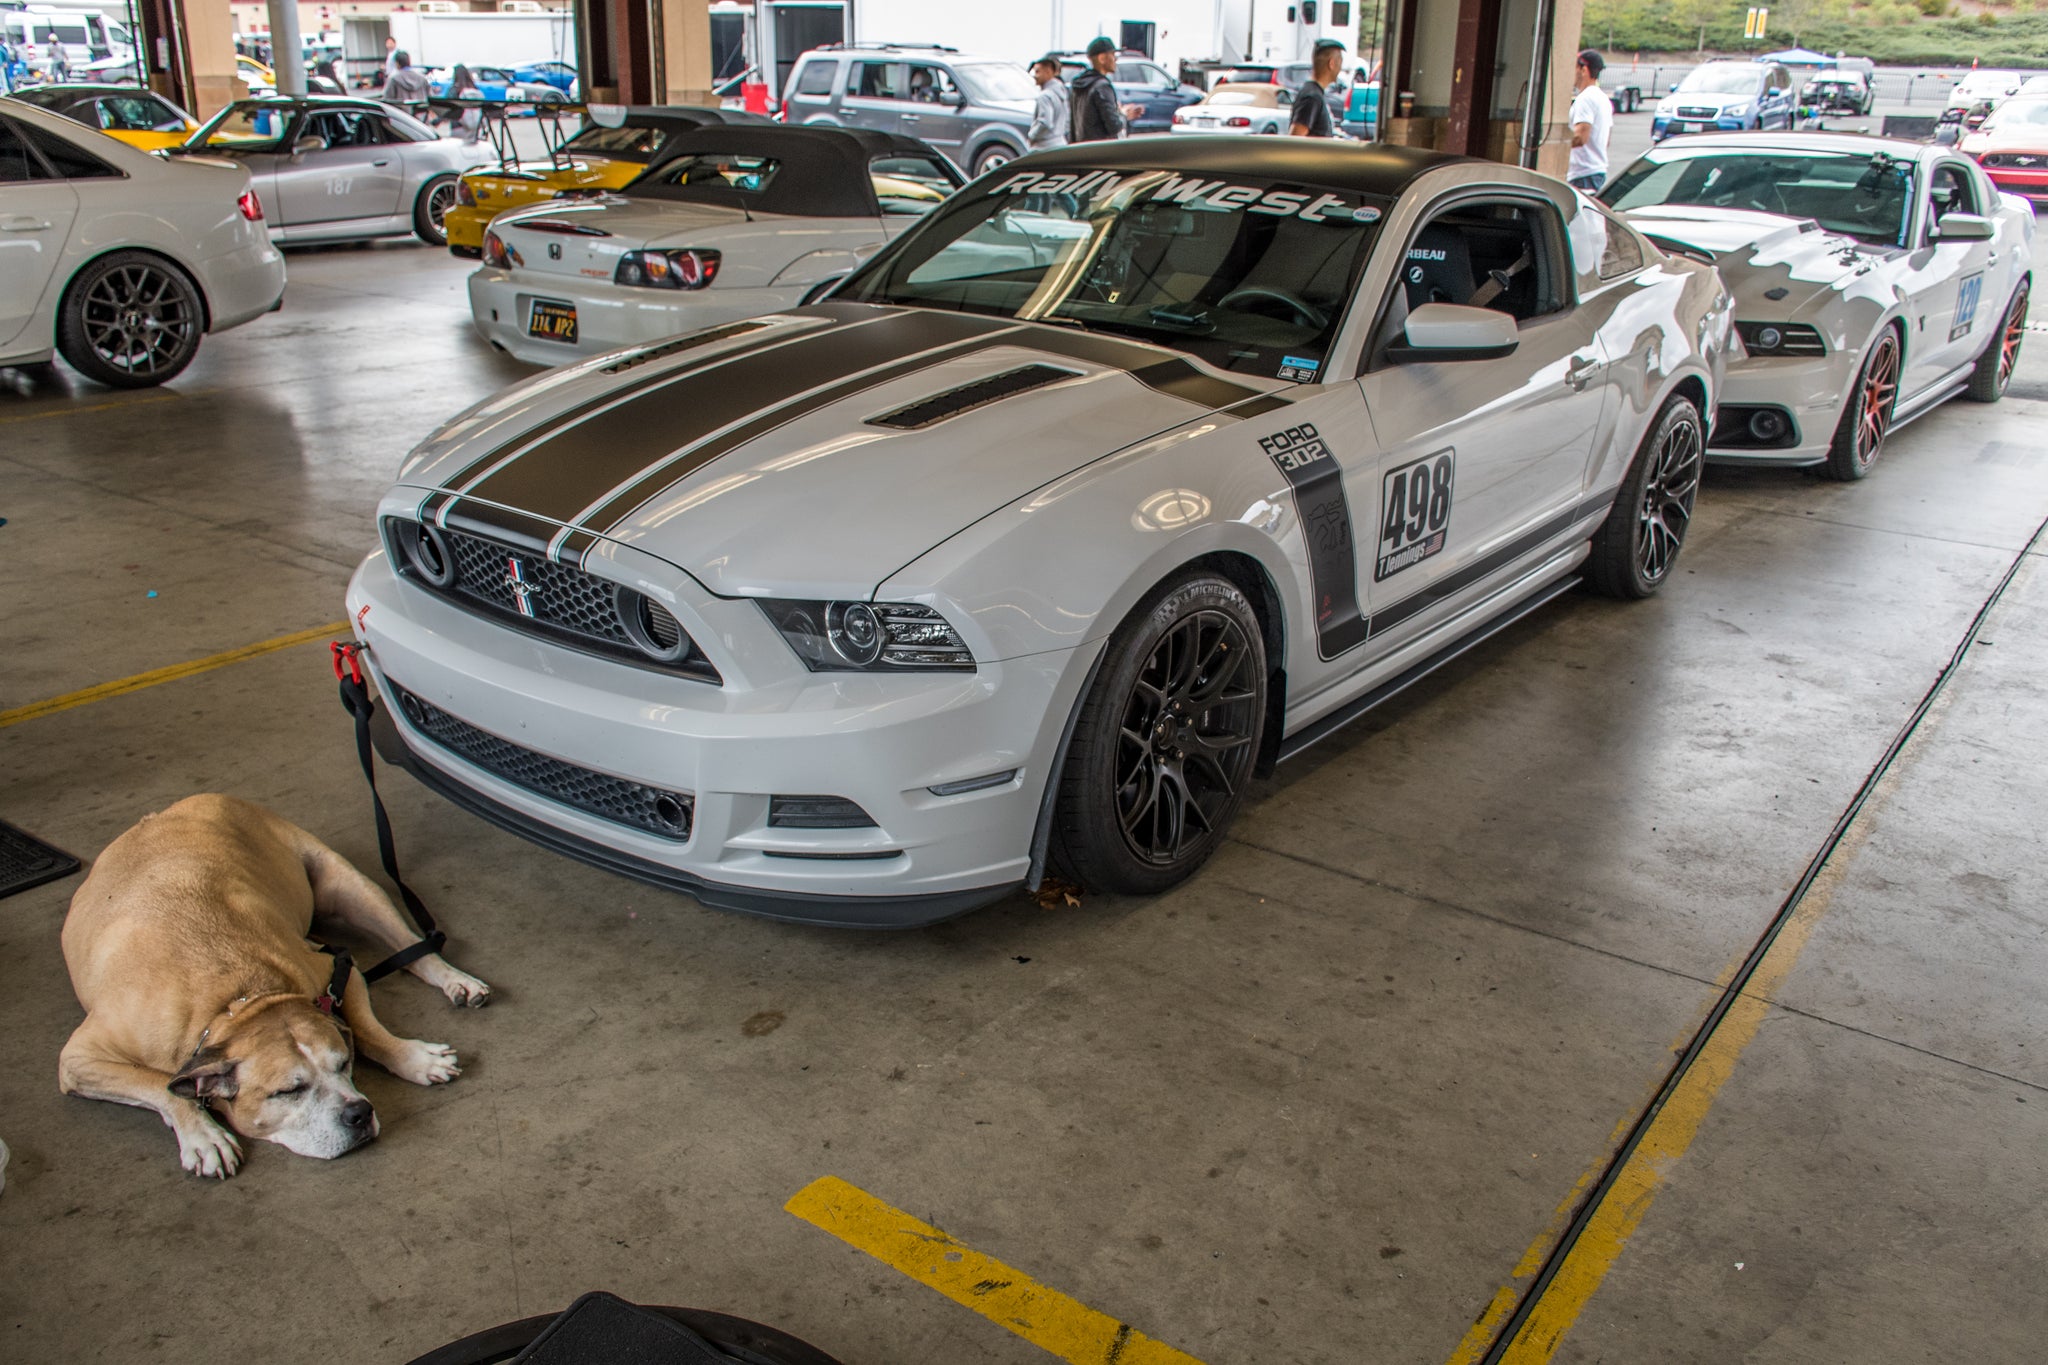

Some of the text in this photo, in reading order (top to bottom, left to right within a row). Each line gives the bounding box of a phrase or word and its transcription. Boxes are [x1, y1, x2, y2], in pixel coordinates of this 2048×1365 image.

[326, 177, 353, 195] 187
[988, 171, 1346, 222] Rally West
[1955, 276, 1983, 326] 120
[1257, 423, 1319, 455] FORD
[1278, 441, 1328, 471] 302
[1383, 455, 1452, 550] 498
[1384, 541, 1427, 575] Jennings
[1191, 585, 1232, 600] MICHELIN
